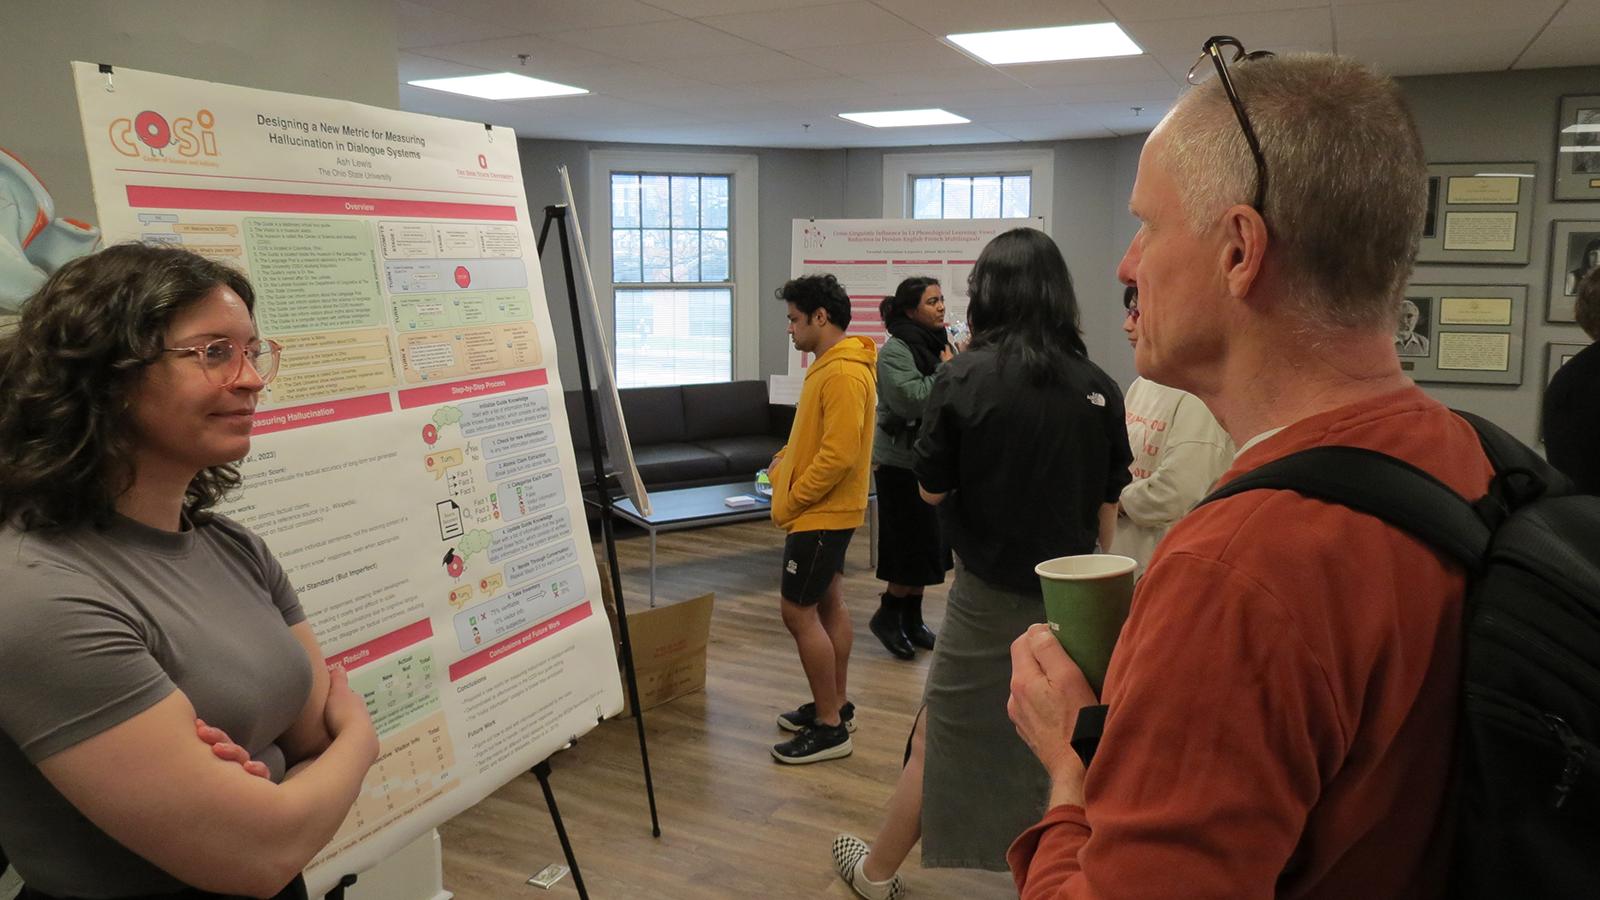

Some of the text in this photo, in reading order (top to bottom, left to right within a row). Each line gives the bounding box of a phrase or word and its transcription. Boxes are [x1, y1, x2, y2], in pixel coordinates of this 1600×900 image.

[258, 115, 425, 149] Designing a New Metric for Measuring
[270, 133, 421, 163] Hallucination in Dialogue Systems
[337, 158, 372, 169] Ash Lewis
[318, 168, 392, 182] The Ohio State University
[345, 203, 374, 211] Overview
[452, 381, 506, 395] Step-by-Step Process
[508, 396, 528, 405] Knowledge
[252, 408, 334, 428] easuring Hallucination
[496, 436, 508, 444] Check
[258, 451, 277, 461] 2023)
[456, 470, 468, 478] Fact
[460, 488, 471, 496] Fact
[306, 576, 335, 591] Standard
[336, 573, 348, 583] (But
[350, 563, 378, 577] Imperfect)
[489, 621, 561, 658] Conclusions and Future Work
[343, 650, 369, 665] Results
[457, 676, 486, 693] Conclusions
[468, 720, 496, 738] Future Work
